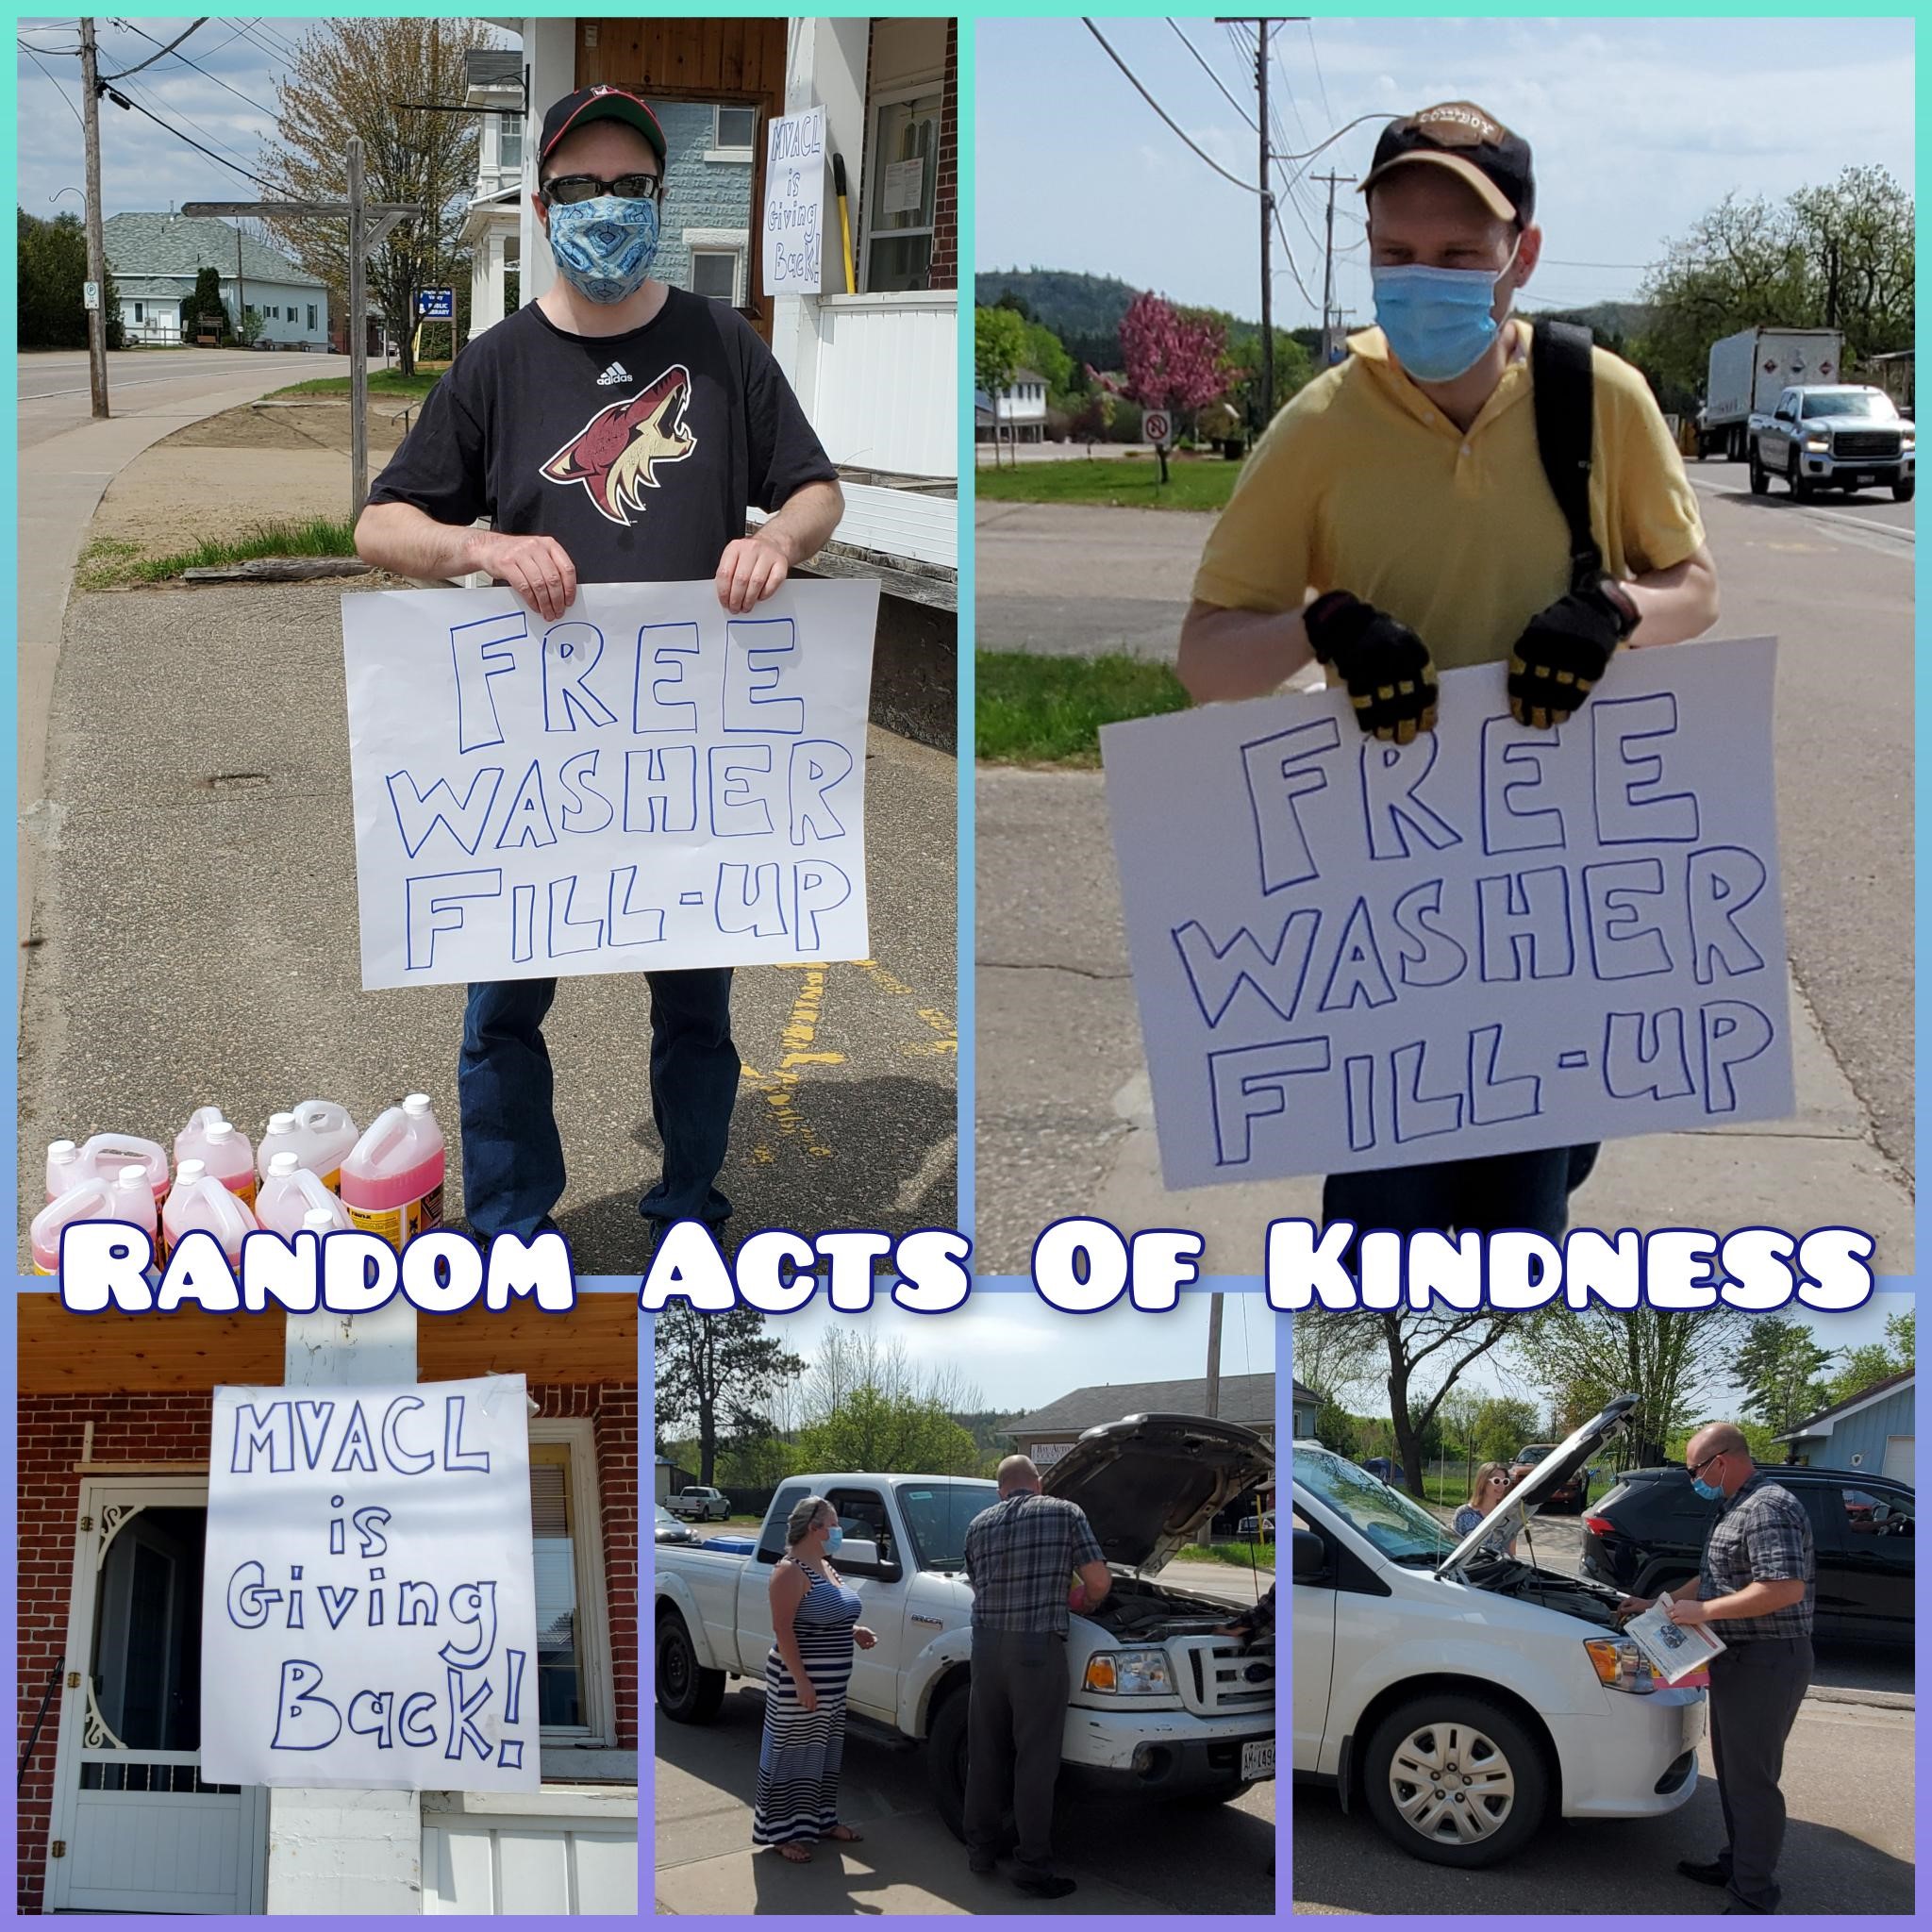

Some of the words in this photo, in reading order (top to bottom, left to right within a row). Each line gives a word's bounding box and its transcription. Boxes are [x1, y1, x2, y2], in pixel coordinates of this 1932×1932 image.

[771, 115, 821, 161] MVACL
[787, 168, 801, 197] is
[768, 200, 818, 243] Giving
[774, 233, 821, 284] Back!
[596, 375, 633, 386] adidas
[449, 611, 805, 755] FREE
[386, 739, 853, 859] WASHER
[1240, 691, 1700, 897] FREE
[405, 858, 852, 970] FILL-UP
[1171, 845, 1767, 1029] WASHER
[1207, 999, 1774, 1167] FILL-UP
[229, 1395, 491, 1474] MVACL
[328, 1494, 392, 1558] is
[226, 1559, 498, 1671] Giving
[270, 1648, 526, 1770] Back!
